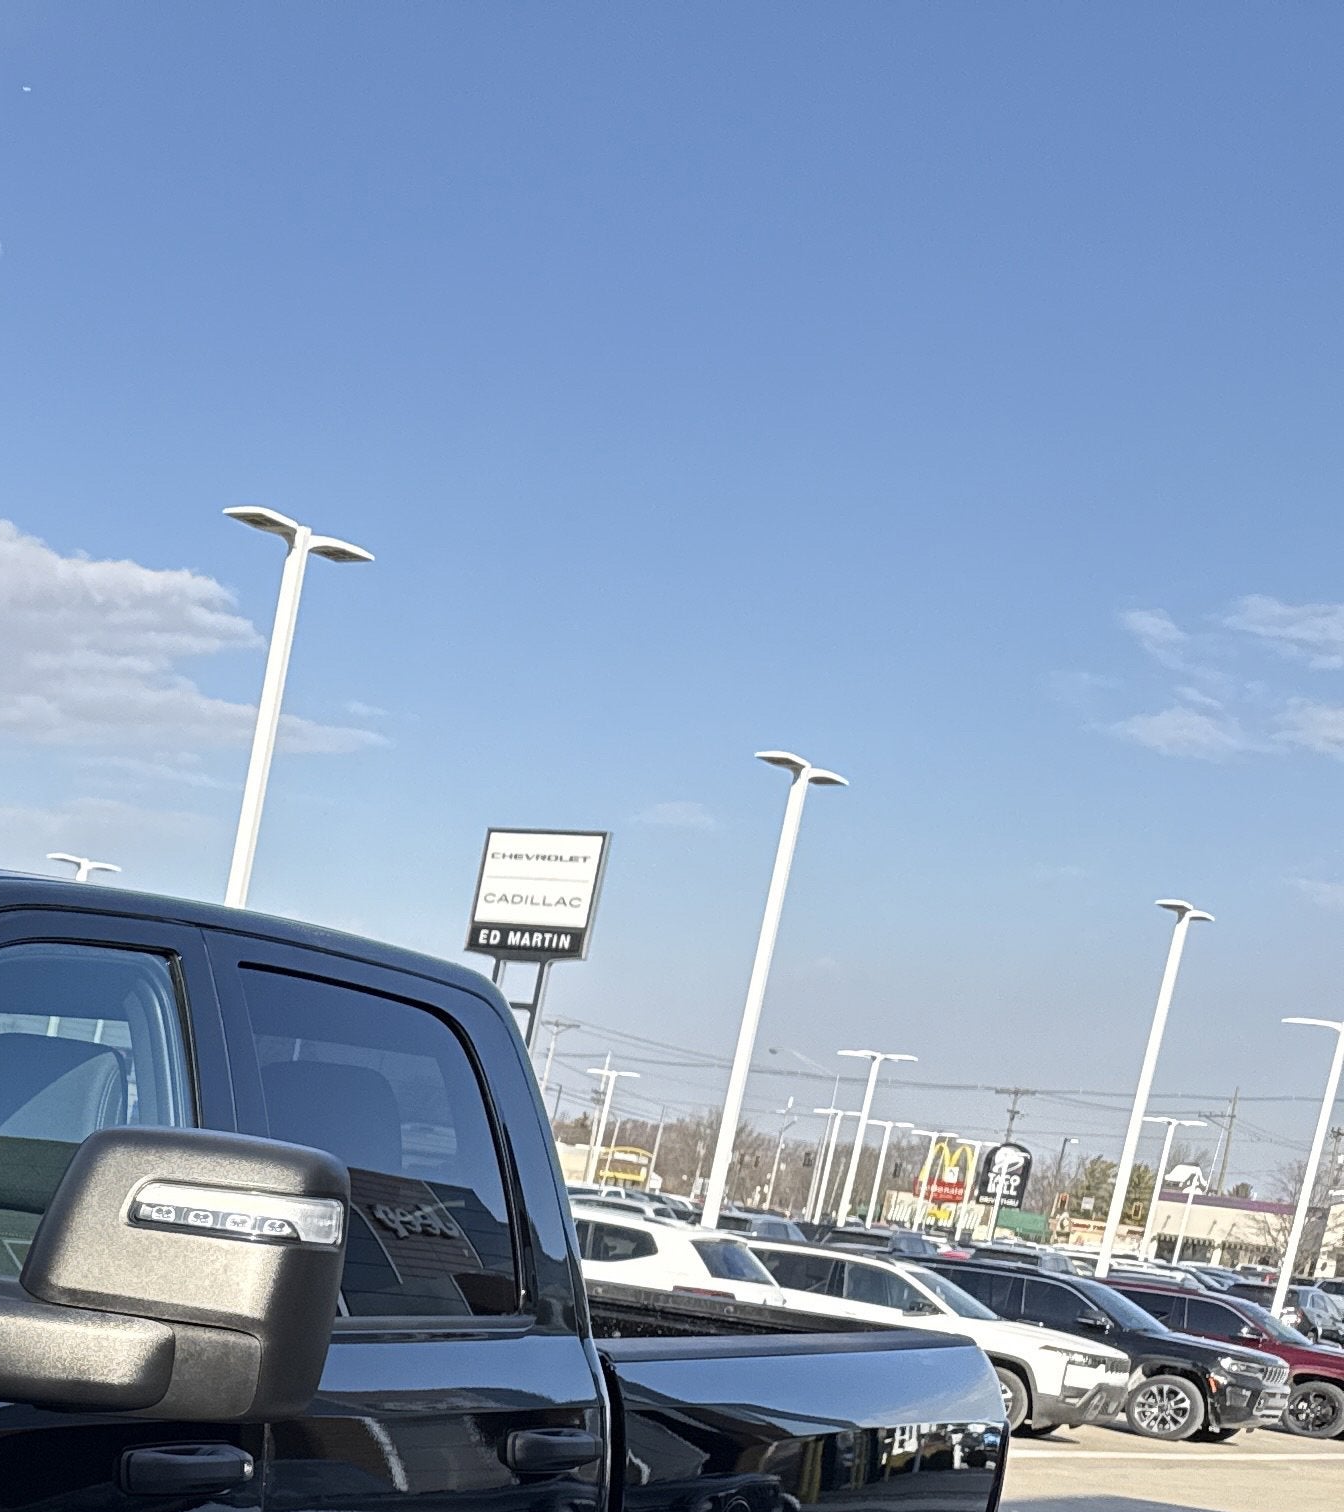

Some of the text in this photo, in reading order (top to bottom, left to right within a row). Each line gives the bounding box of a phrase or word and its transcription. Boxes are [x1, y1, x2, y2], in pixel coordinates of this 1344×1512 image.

[490, 852, 591, 863] CHEVROLET
[483, 892, 583, 909] CADILLAC
[478, 928, 572, 950] ED MARTIN
[986, 1182, 1018, 1196] BLL
